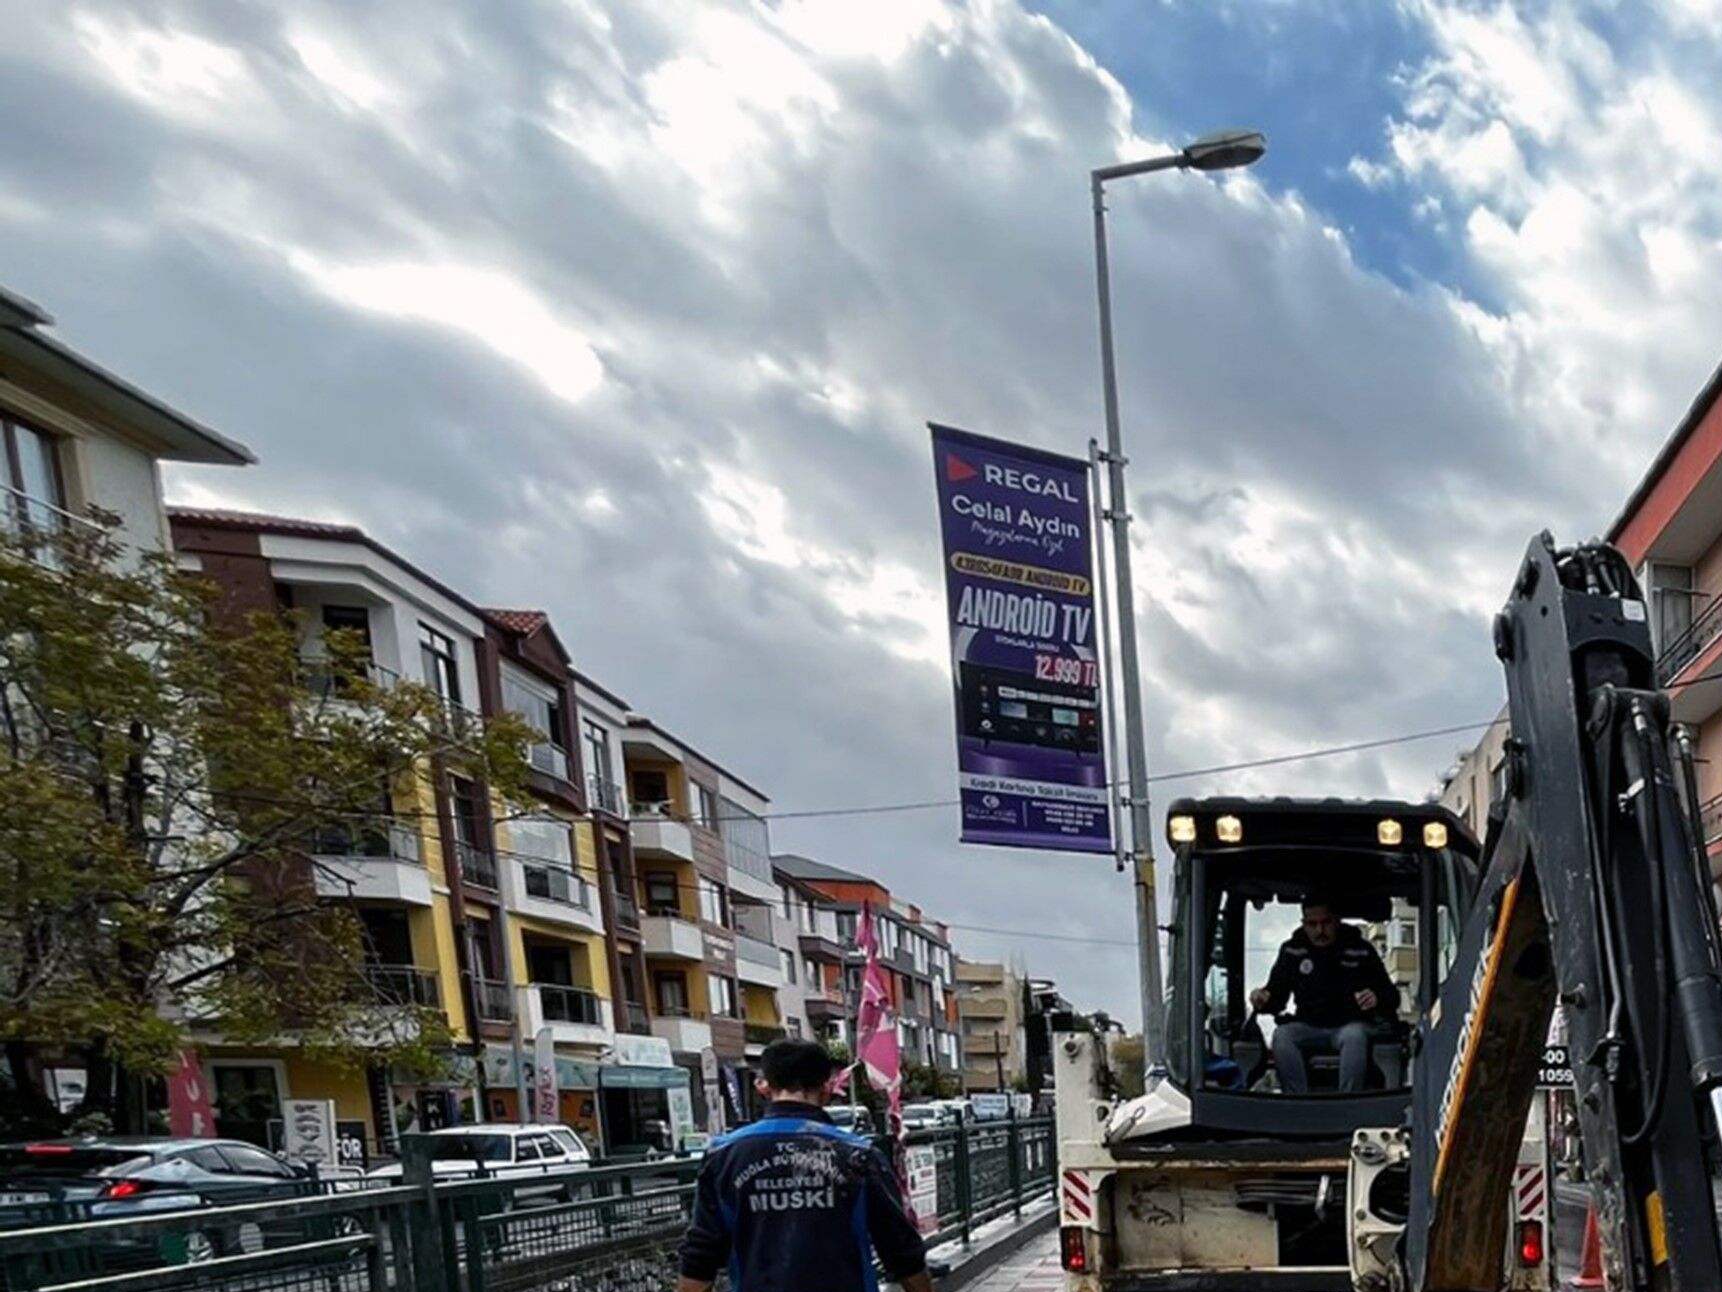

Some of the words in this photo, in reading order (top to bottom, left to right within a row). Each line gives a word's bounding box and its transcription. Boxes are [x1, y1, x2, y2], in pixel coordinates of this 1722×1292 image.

[984, 464, 1079, 503] REGAL
[952, 494, 1012, 523] Celal
[1018, 509, 1080, 539] Aydın
[957, 586, 1057, 638] ANDROİD
[1061, 604, 1091, 644] TV
[1035, 655, 1081, 684] 12.999
[1083, 662, 1098, 687] TL
[749, 1186, 834, 1213] MUSKİ
